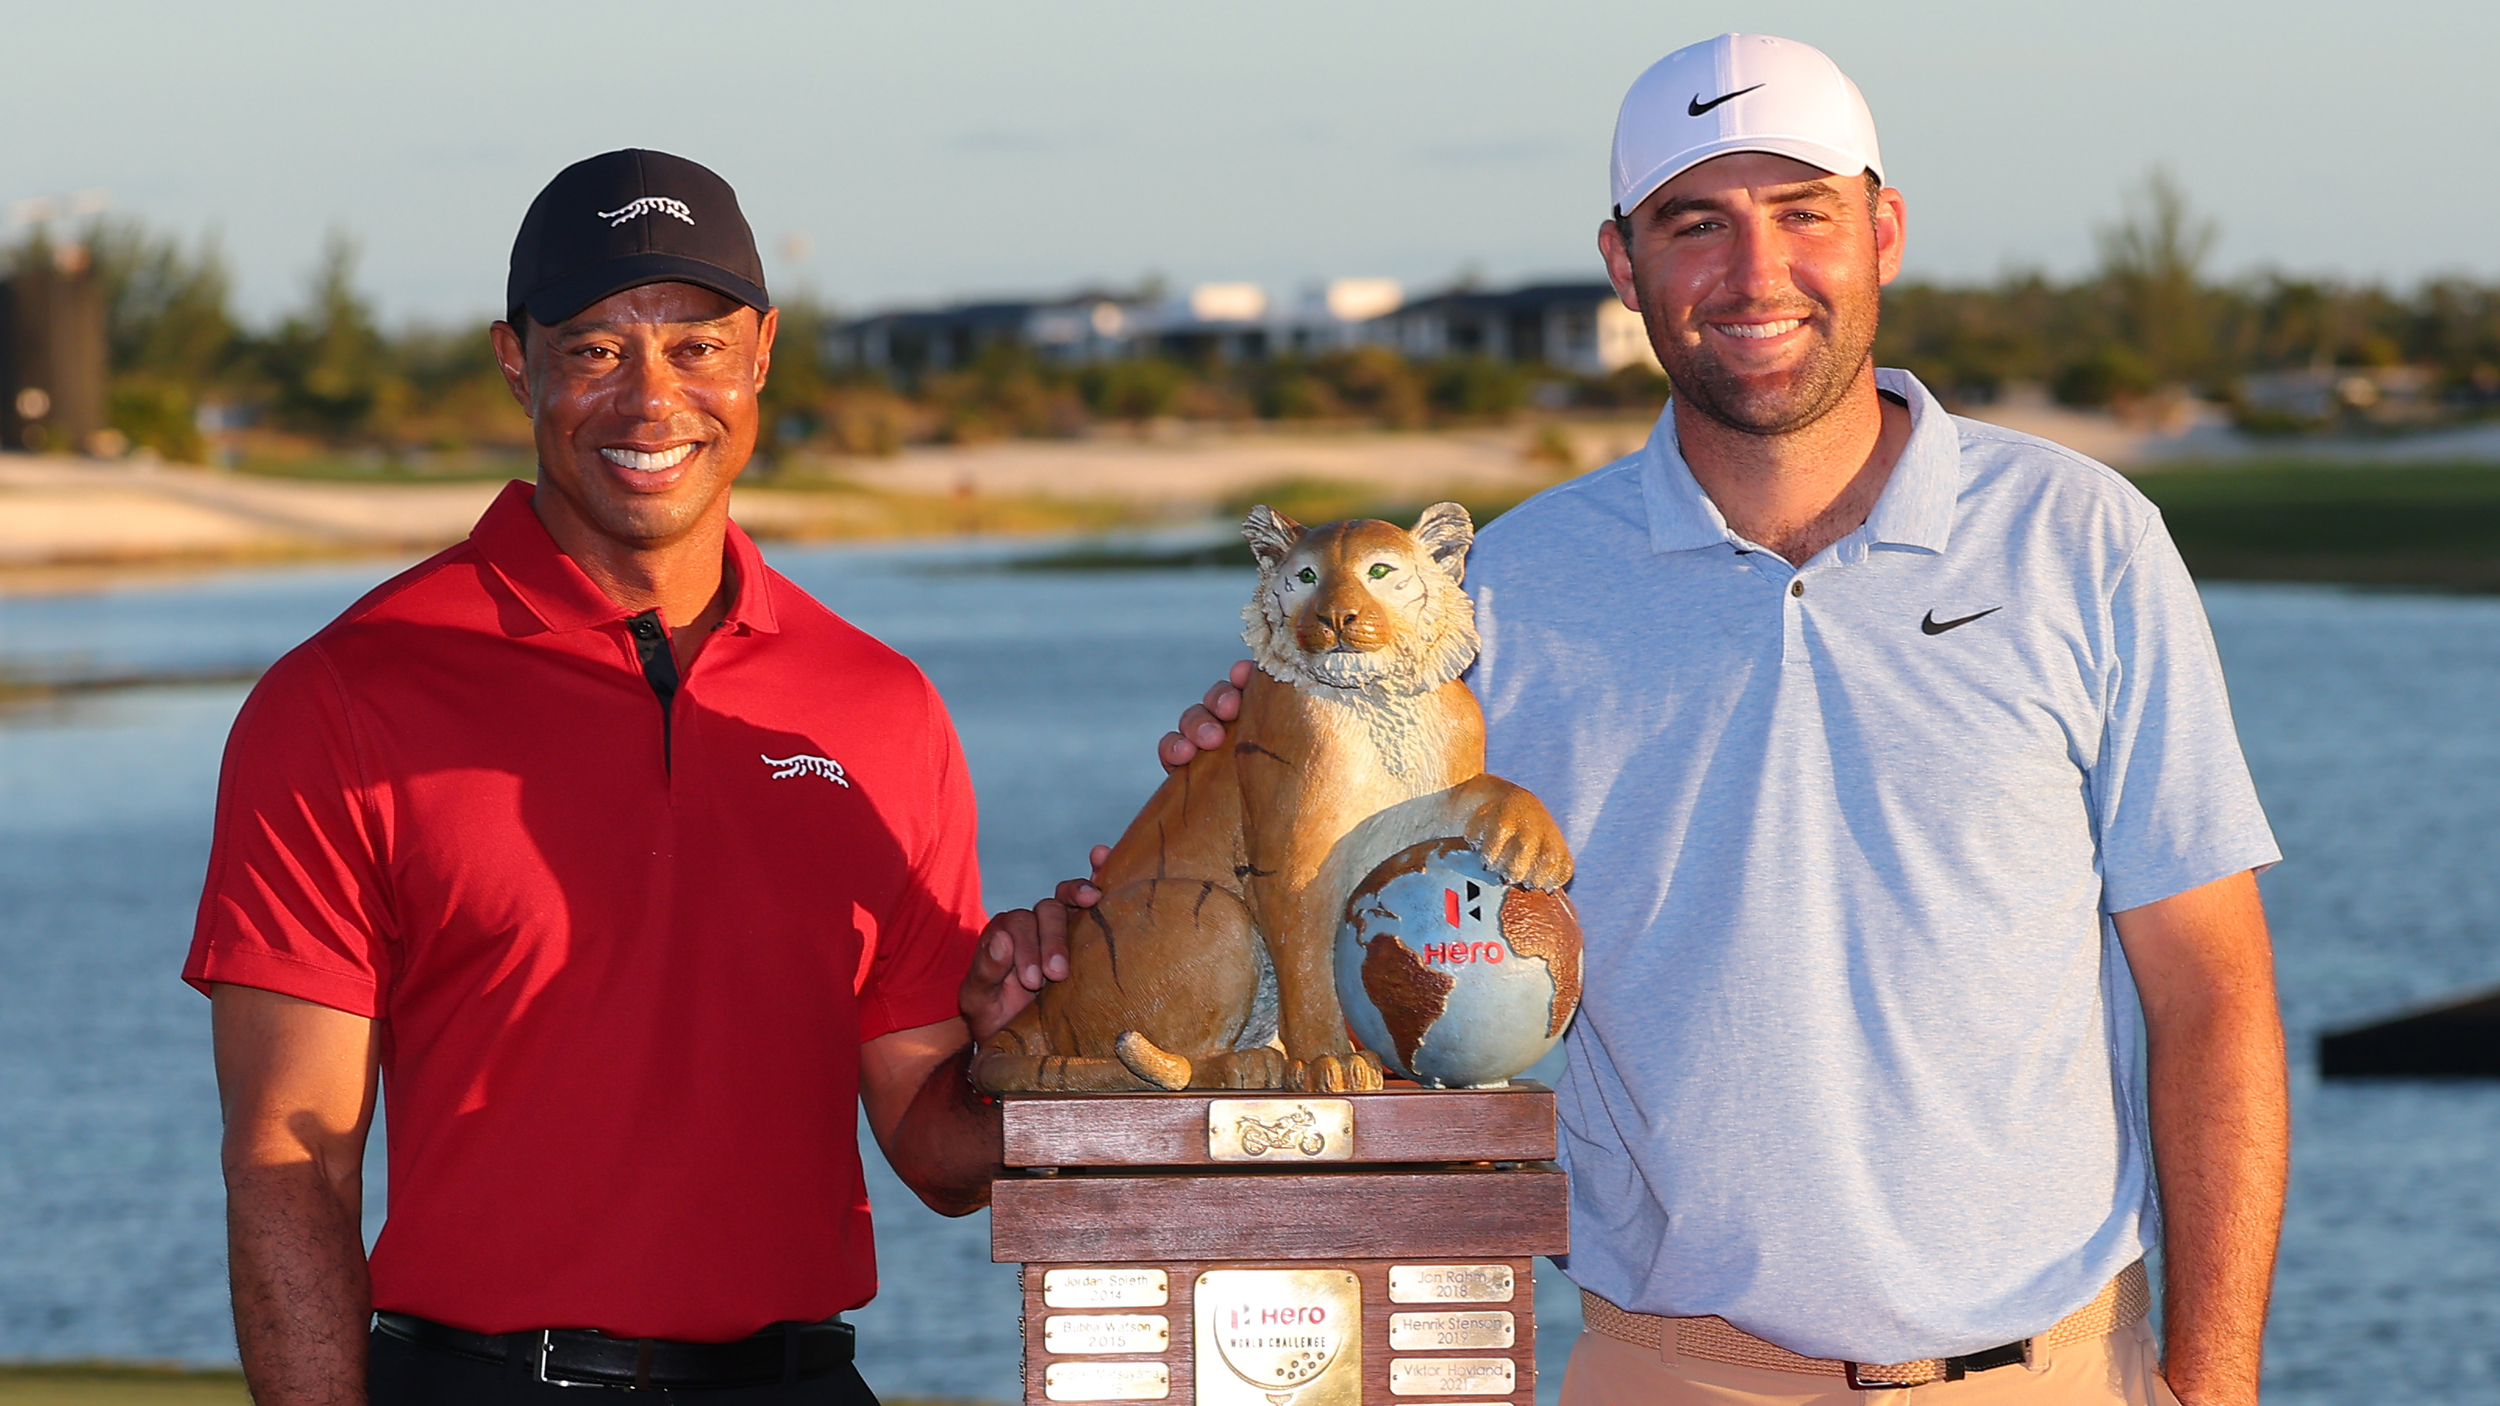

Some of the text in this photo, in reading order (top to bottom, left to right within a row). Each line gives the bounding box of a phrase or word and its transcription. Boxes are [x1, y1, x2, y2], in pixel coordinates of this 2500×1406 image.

[1423, 941, 1505, 965] Hero
[1064, 1274, 1149, 1288] Jordan Spieth
[1417, 1271, 1487, 1284] Jon Rahm
[1090, 1290, 1122, 1301] 2014
[1436, 1285, 1468, 1298] 2018
[1261, 1306, 1326, 1325] Hero
[1403, 1317, 1502, 1330] Henrik Stenson
[1088, 1335, 1126, 1347] 2015
[1230, 1337, 1326, 1348] WORLD CHALLENGE
[1437, 1331, 1468, 1344] 2019
[1403, 1364, 1503, 1377] Viktor Hovland
[1439, 1378, 1468, 1391] 2021
